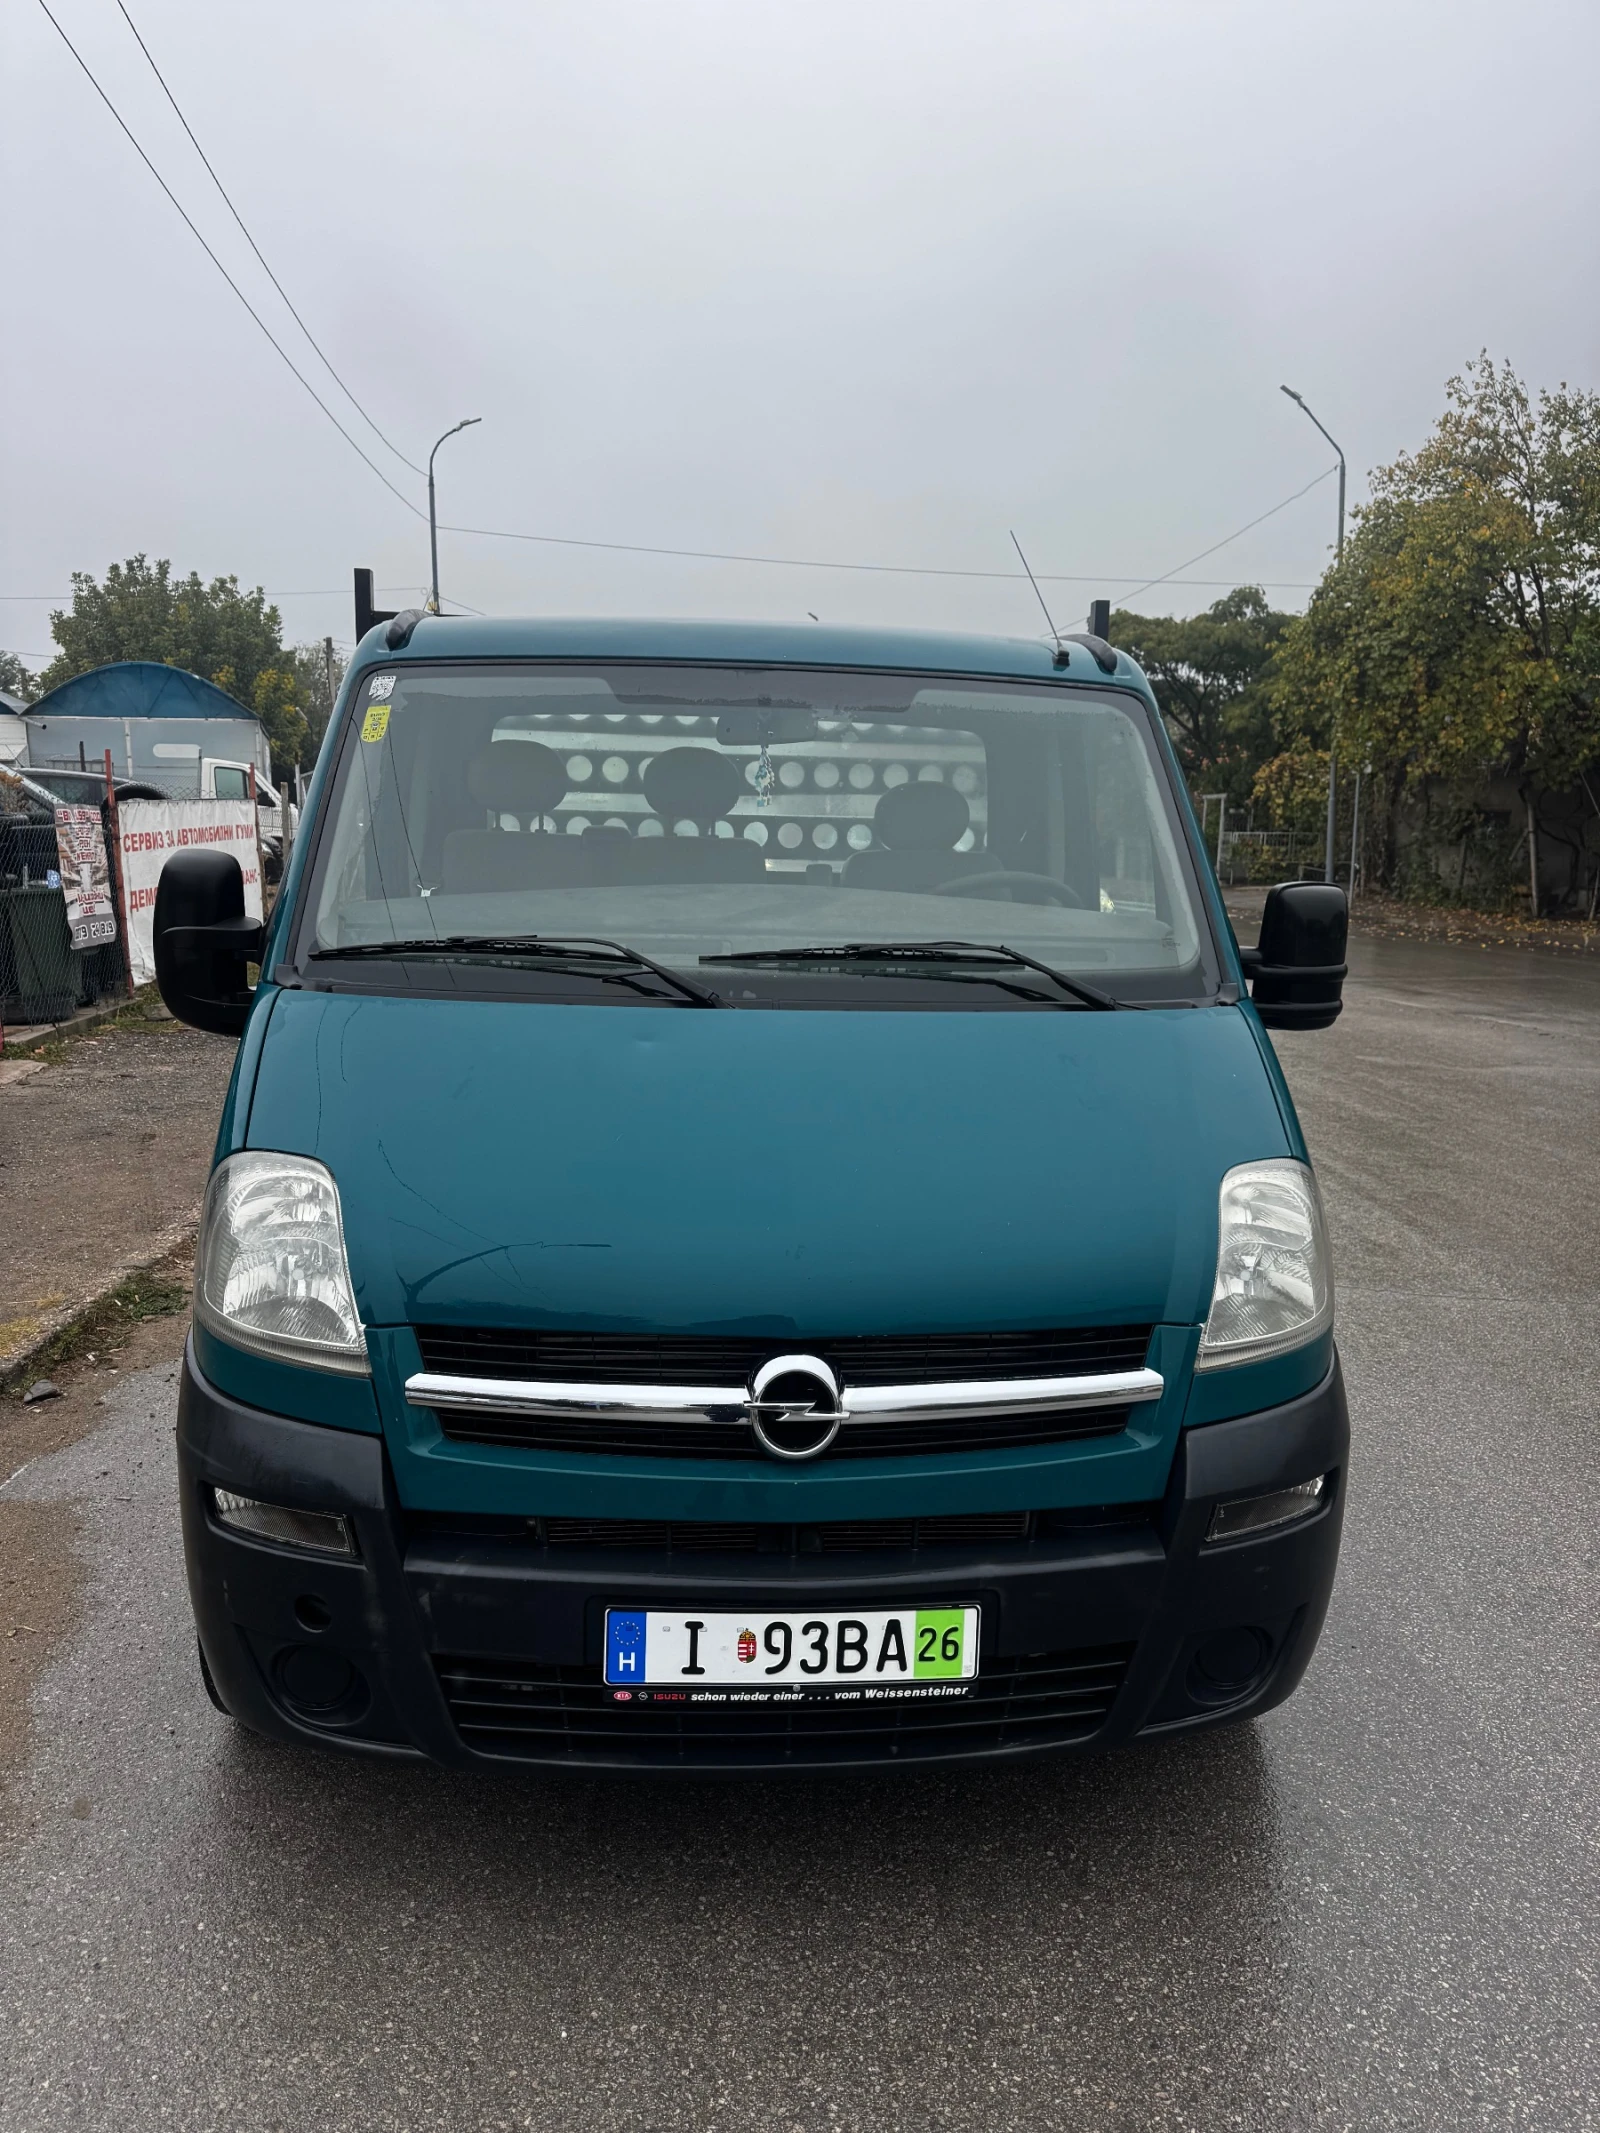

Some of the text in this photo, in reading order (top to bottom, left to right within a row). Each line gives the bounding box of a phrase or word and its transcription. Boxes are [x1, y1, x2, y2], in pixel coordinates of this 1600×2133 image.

[123, 824, 254, 853] СЕРВИЗ ЗА АВТОМОБИЛНИ ГУМИ
[618, 1652, 636, 1672] H
[681, 1620, 706, 1675] I
[763, 1618, 908, 1675] 93BA
[918, 1626, 960, 1663] 26
[691, 1692, 726, 1701] schon
[730, 1691, 770, 1701] wieder
[773, 1691, 805, 1701] einer
[834, 1692, 861, 1700] vom
[864, 1686, 969, 1699] Weissensteiner
